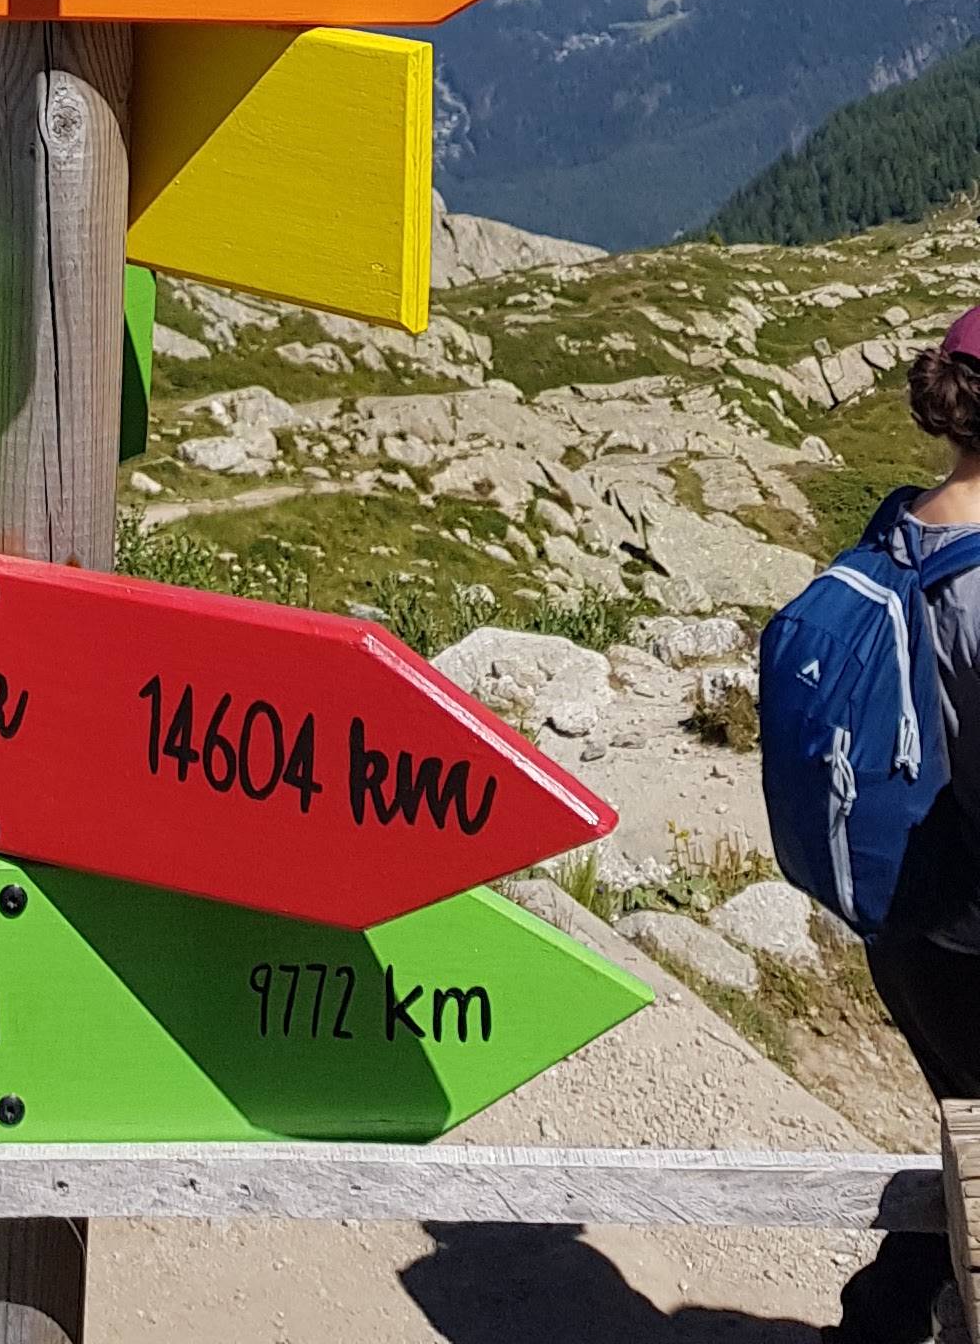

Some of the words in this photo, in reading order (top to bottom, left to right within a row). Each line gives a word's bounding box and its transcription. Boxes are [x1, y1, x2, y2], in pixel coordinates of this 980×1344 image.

[139, 675, 323, 814] 14604
[348, 716, 498, 836] km
[248, 963, 356, 1042] 9772
[383, 964, 493, 1044] km
